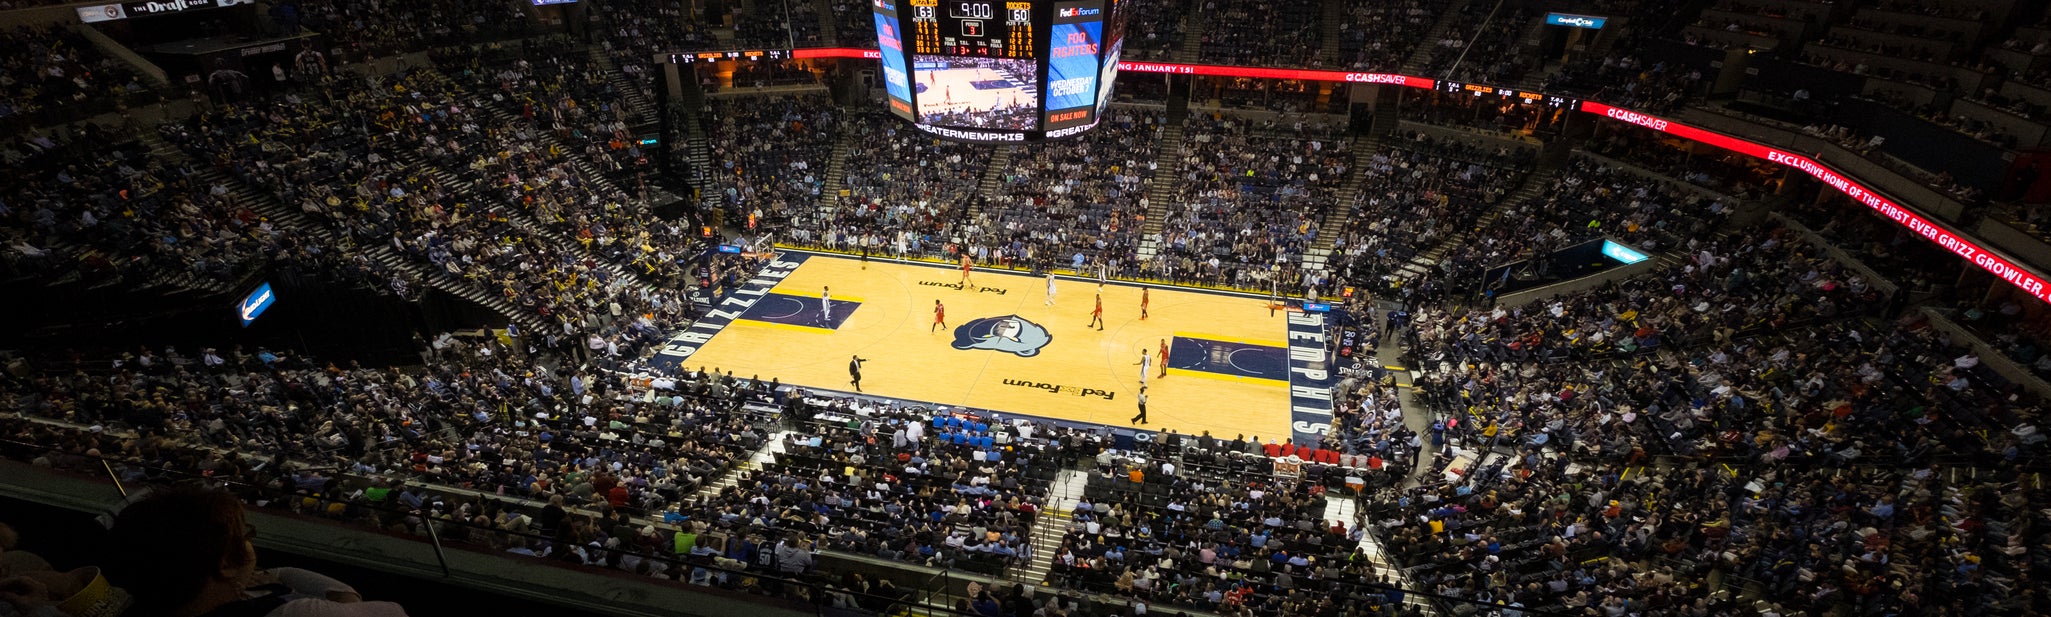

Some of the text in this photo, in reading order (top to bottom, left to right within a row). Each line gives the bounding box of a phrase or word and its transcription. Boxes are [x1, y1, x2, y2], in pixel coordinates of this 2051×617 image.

[147, 0, 188, 13] Draft
[920, 6, 933, 17] 63
[961, 3, 990, 17] 9:00
[1060, 8, 1099, 17] FedExForum
[1014, 10, 1027, 20] 60
[970, 26, 976, 35] 3
[1067, 32, 1086, 44] FOO
[961, 46, 966, 55] 3
[1052, 43, 1098, 58] FIGHTERS
[1117, 63, 1194, 74] NG JANUARY 15!
[1050, 76, 1094, 90] WEDNESDAY
[1354, 73, 1406, 85] CASHSAVER
[1053, 84, 1090, 97] OCTOBER 7
[1465, 84, 1493, 94] GRIZZLIES
[1519, 91, 1543, 101] ROCKETS
[1050, 110, 1088, 123] ON SALE NOW
[1616, 109, 1668, 131] CASHSAVER
[1768, 151, 2045, 299] EXCLUSIVE HOME OF THE FIRST EVER GRIZZ GROWLER,
[660, 260, 799, 357] GRIZZLIES
[1289, 311, 1332, 436] MEMPHIS
[759, 553, 770, 566] 50
